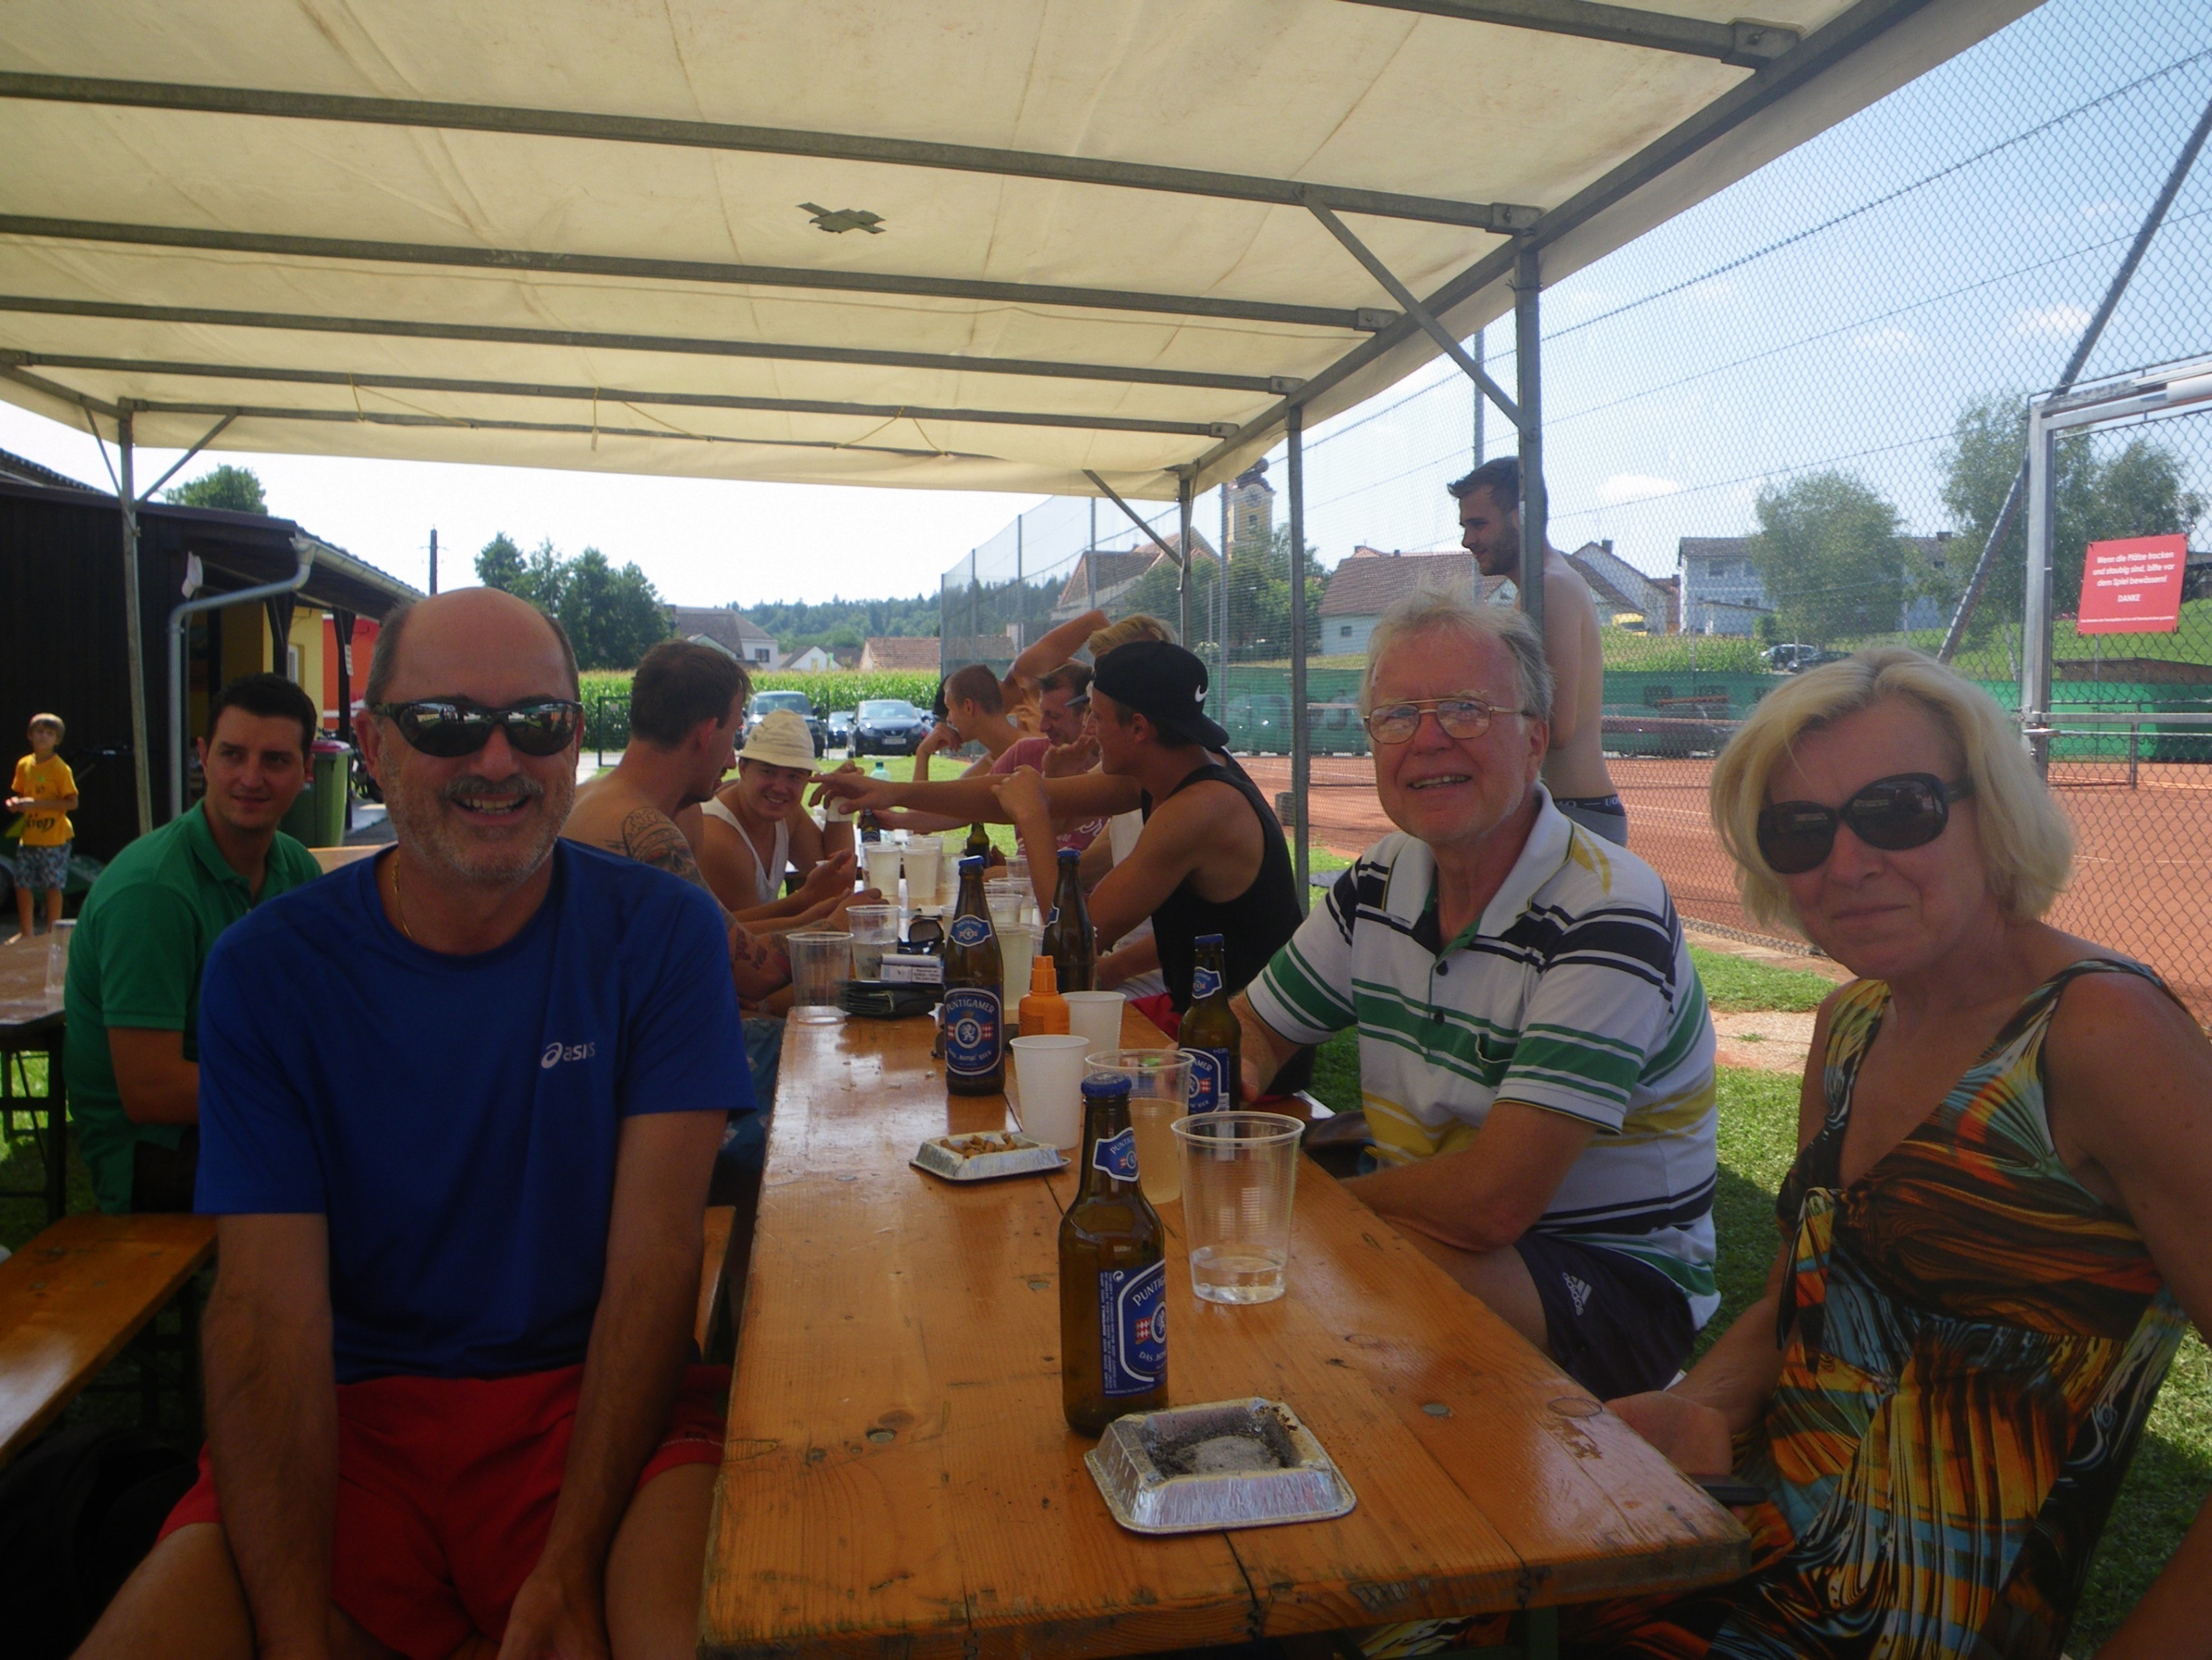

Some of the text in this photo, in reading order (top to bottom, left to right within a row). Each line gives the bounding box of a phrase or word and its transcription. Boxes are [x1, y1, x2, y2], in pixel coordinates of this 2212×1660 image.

[2127, 553, 2147, 561] Plätze
[2147, 551, 2174, 559] trocken
[2093, 567, 2105, 576] und
[2106, 566, 2129, 576] staubig
[2147, 563, 2162, 571] bitte
[2097, 579, 2112, 587] dem
[2113, 578, 2129, 587] Spiel
[2117, 594, 2141, 602] DANKE
[946, 998, 995, 1014] PUNTIGAMER
[1562, 1271, 1584, 1316] adidas
